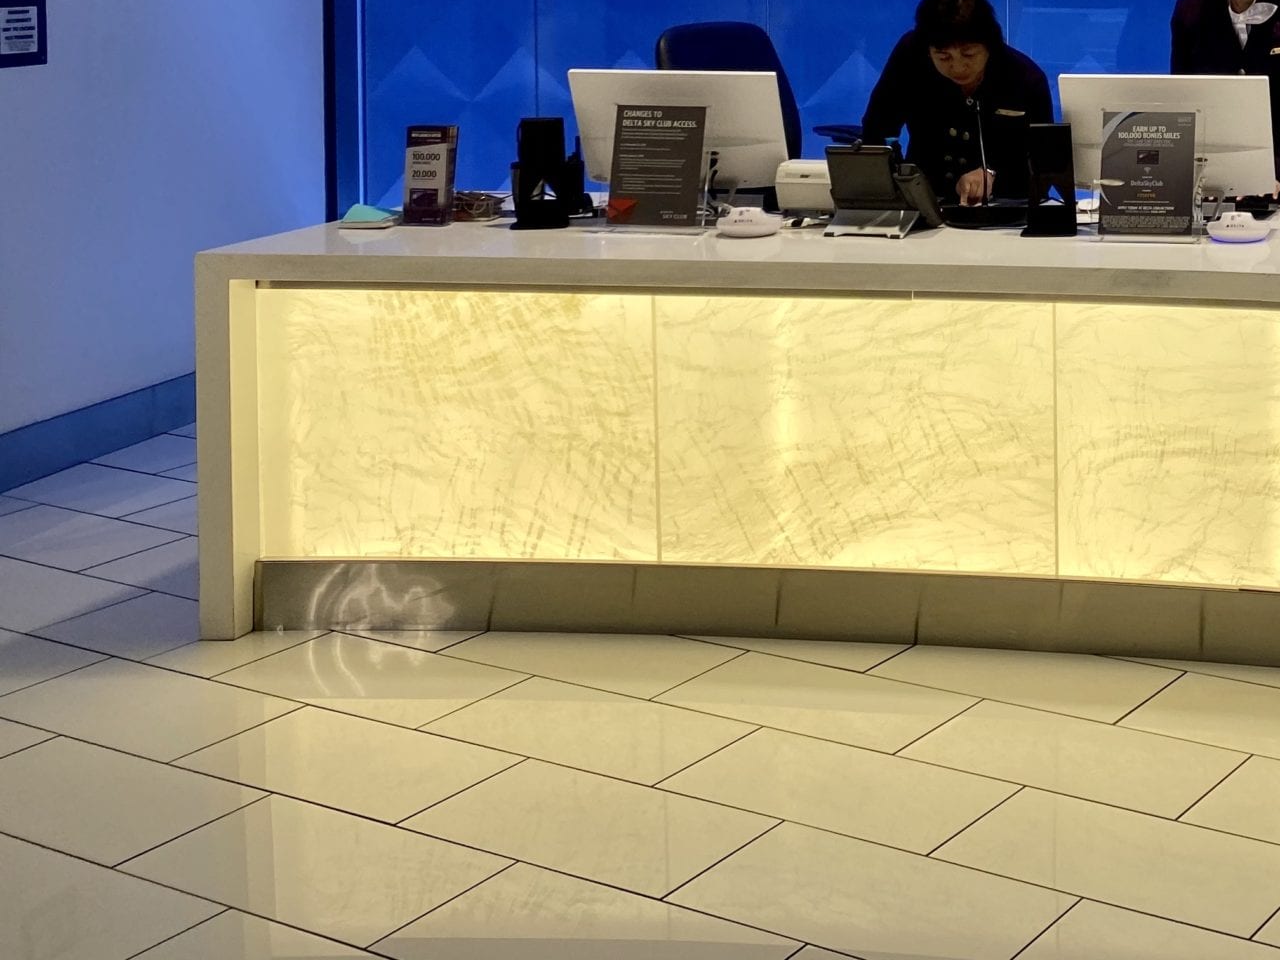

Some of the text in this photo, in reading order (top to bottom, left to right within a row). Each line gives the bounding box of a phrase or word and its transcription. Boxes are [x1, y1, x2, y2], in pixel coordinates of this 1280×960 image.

[623, 110, 652, 118] CHANGES
[622, 119, 642, 127] DELTA
[656, 120, 672, 128] CLUB
